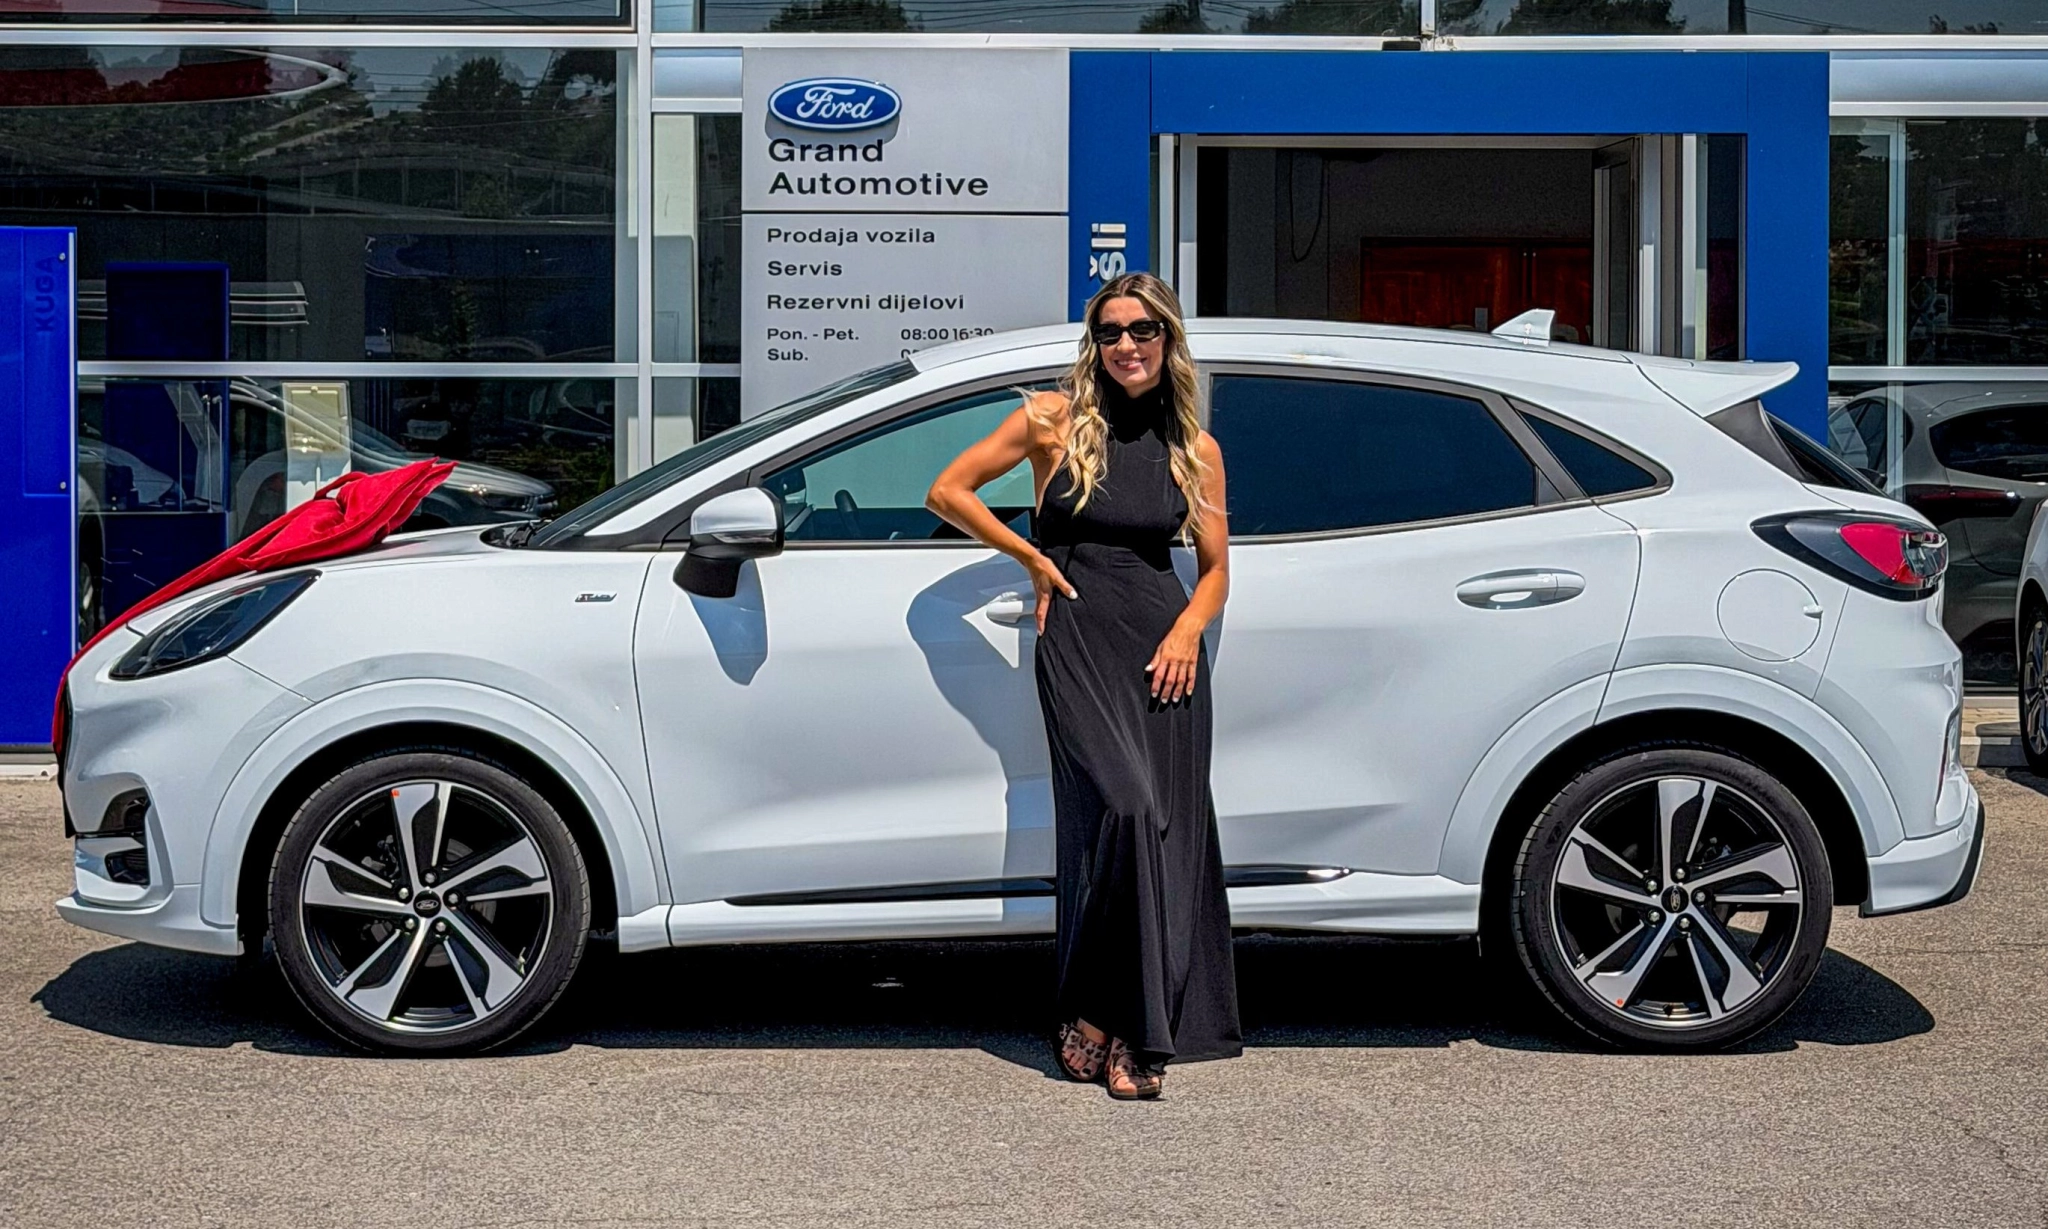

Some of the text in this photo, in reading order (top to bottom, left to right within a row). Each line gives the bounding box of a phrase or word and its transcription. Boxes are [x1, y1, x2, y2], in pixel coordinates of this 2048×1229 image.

[796, 86, 876, 119] Ford
[768, 138, 883, 162] Grand
[768, 172, 989, 196] Automotive
[767, 228, 936, 247] Prodaja vozila
[767, 261, 843, 277] Servis
[35, 256, 55, 332] KUGA
[767, 294, 965, 314] Rezervni dijelovi
[767, 328, 808, 340] Pon.
[823, 328, 860, 341] Pet.
[900, 328, 949, 341] 08:00
[767, 348, 809, 361] Sub.
